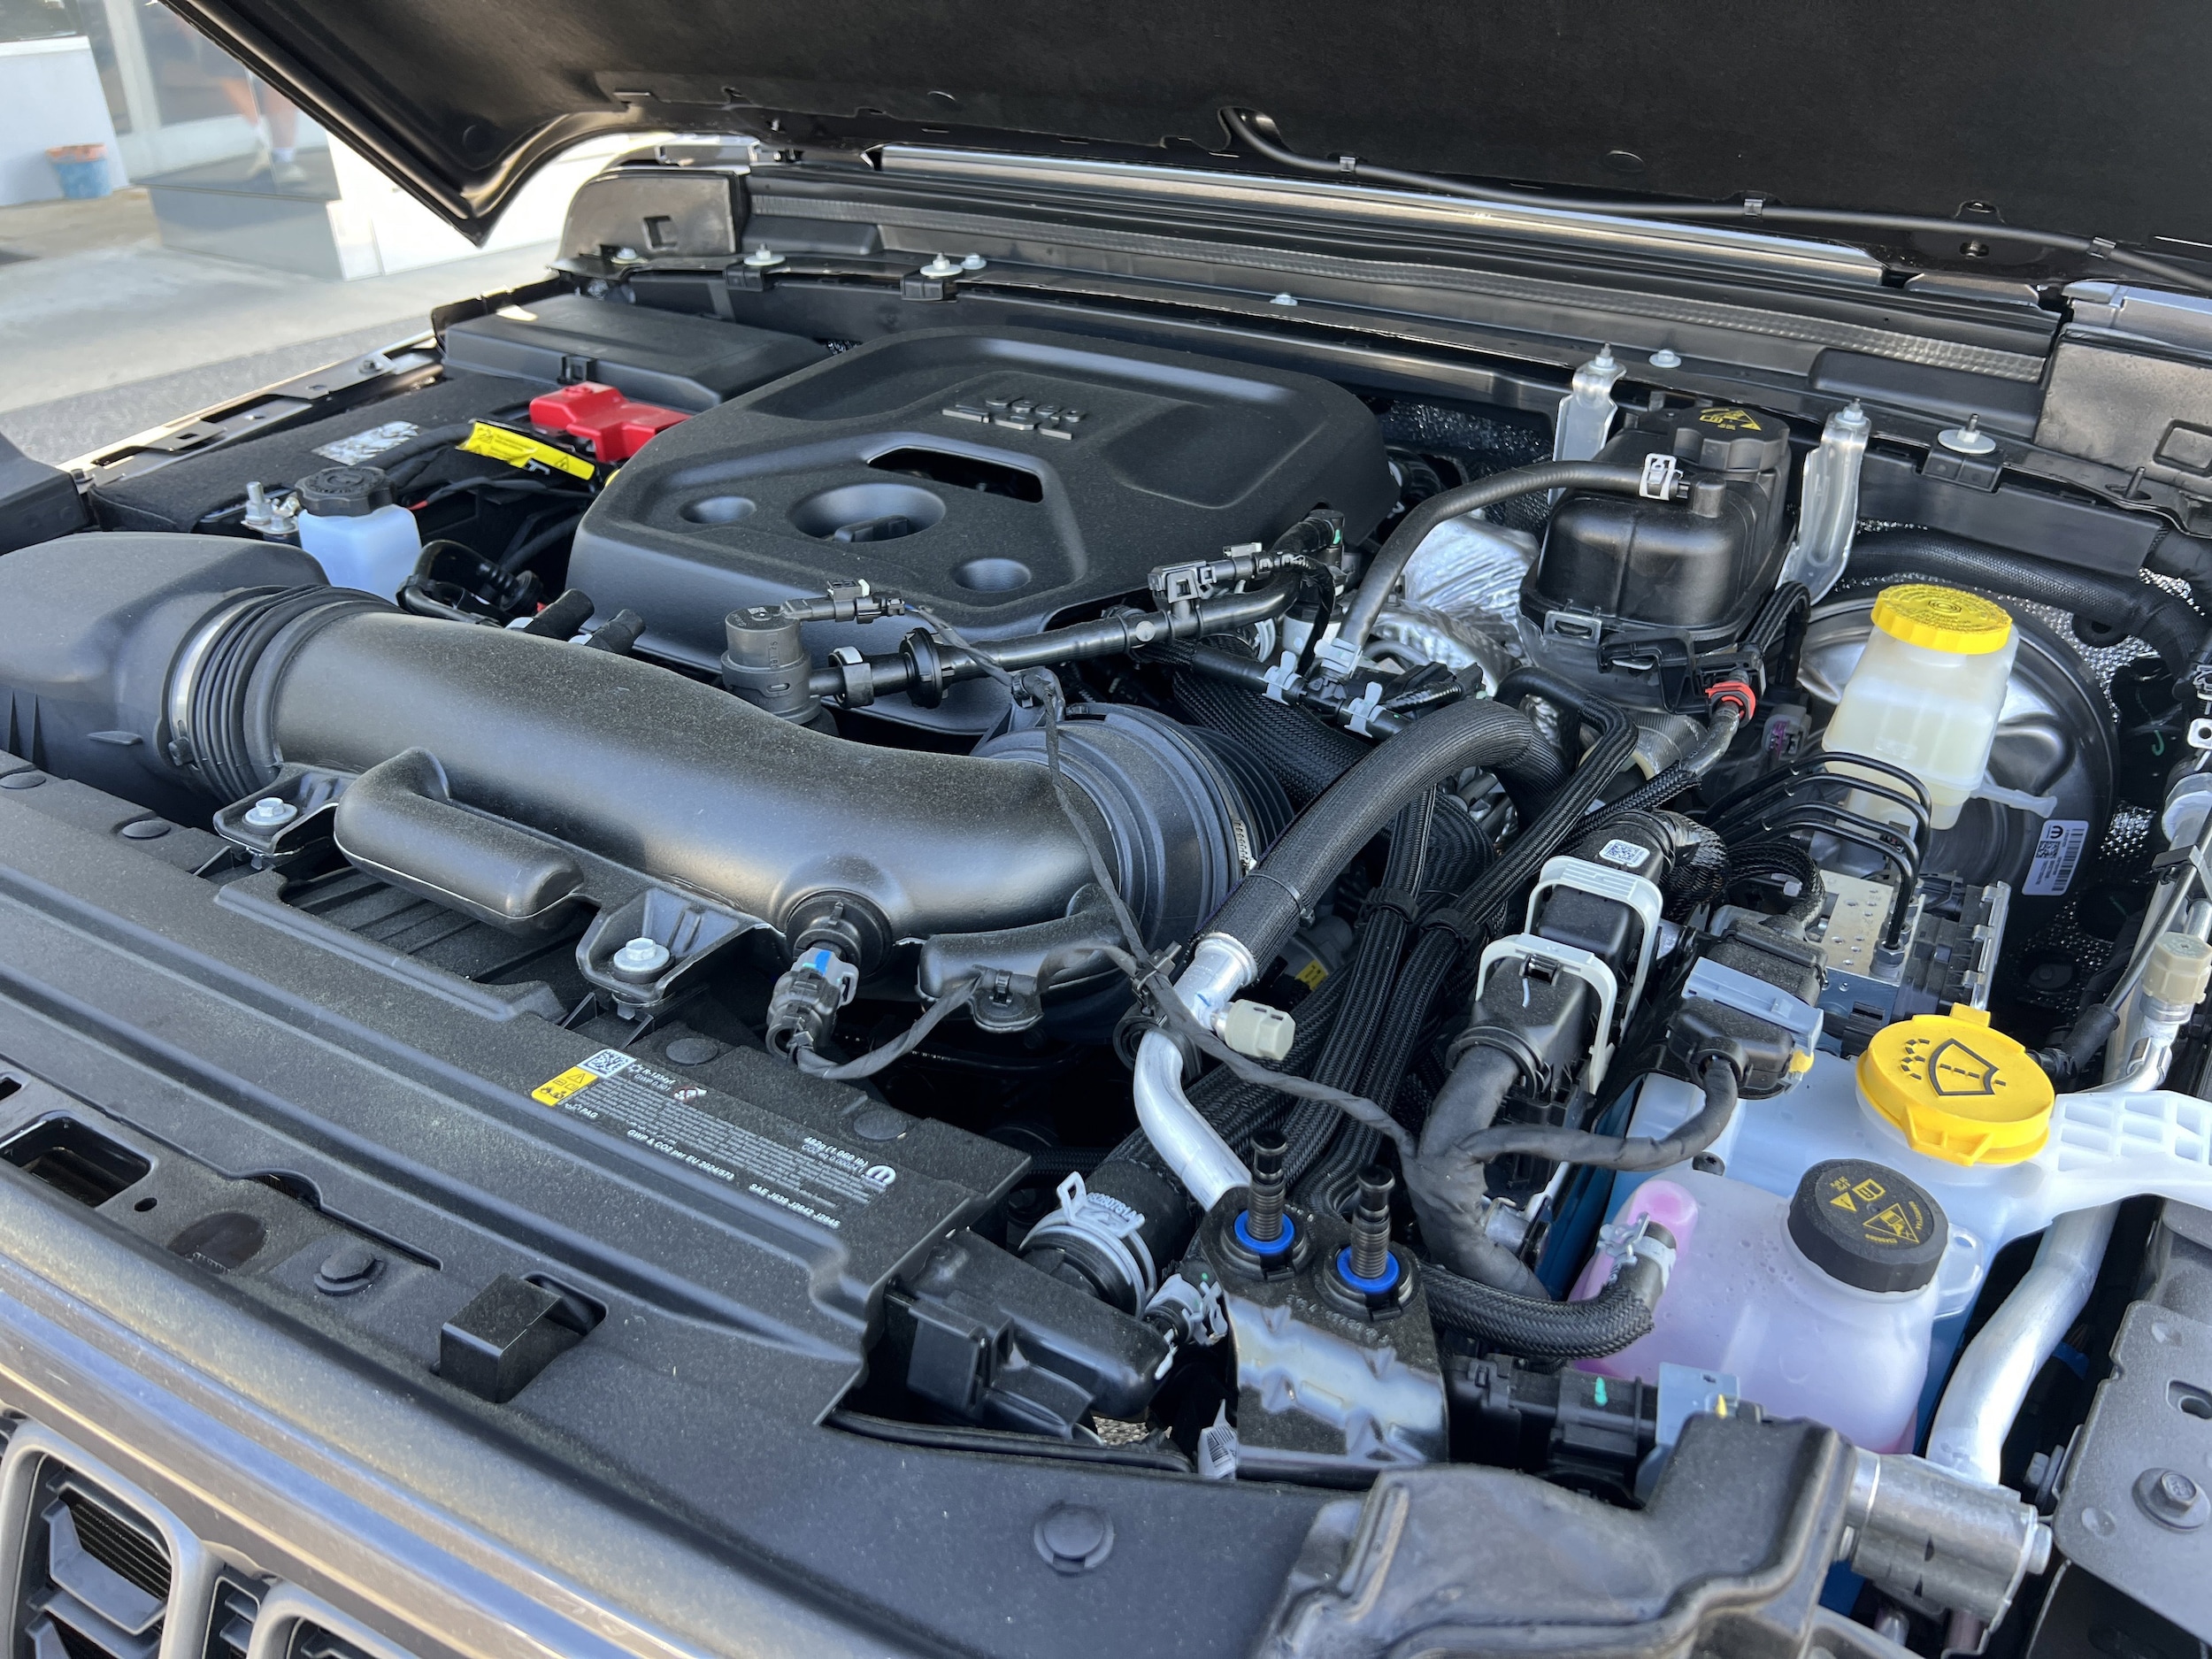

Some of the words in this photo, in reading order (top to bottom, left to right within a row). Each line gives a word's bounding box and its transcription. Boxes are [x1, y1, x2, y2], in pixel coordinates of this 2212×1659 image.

[634, 1073, 651, 1084] GWP
[641, 1068, 676, 1085] R-1234yf
[580, 1106, 599, 1119] PAG
[626, 1129, 648, 1143] GWP
[646, 1138, 656, 1147] &
[655, 1141, 674, 1154] CO2
[672, 1148, 687, 1161] per
[685, 1154, 700, 1166] EU
[698, 1161, 735, 1181] 2024/573
[803, 1136, 827, 1151] 482g
[854, 1155, 869, 1168] lb)
[749, 1183, 769, 1197] SAE
[767, 1194, 789, 1207] J639
[787, 1201, 815, 1217] J2842
[812, 1212, 841, 1229] J2845
